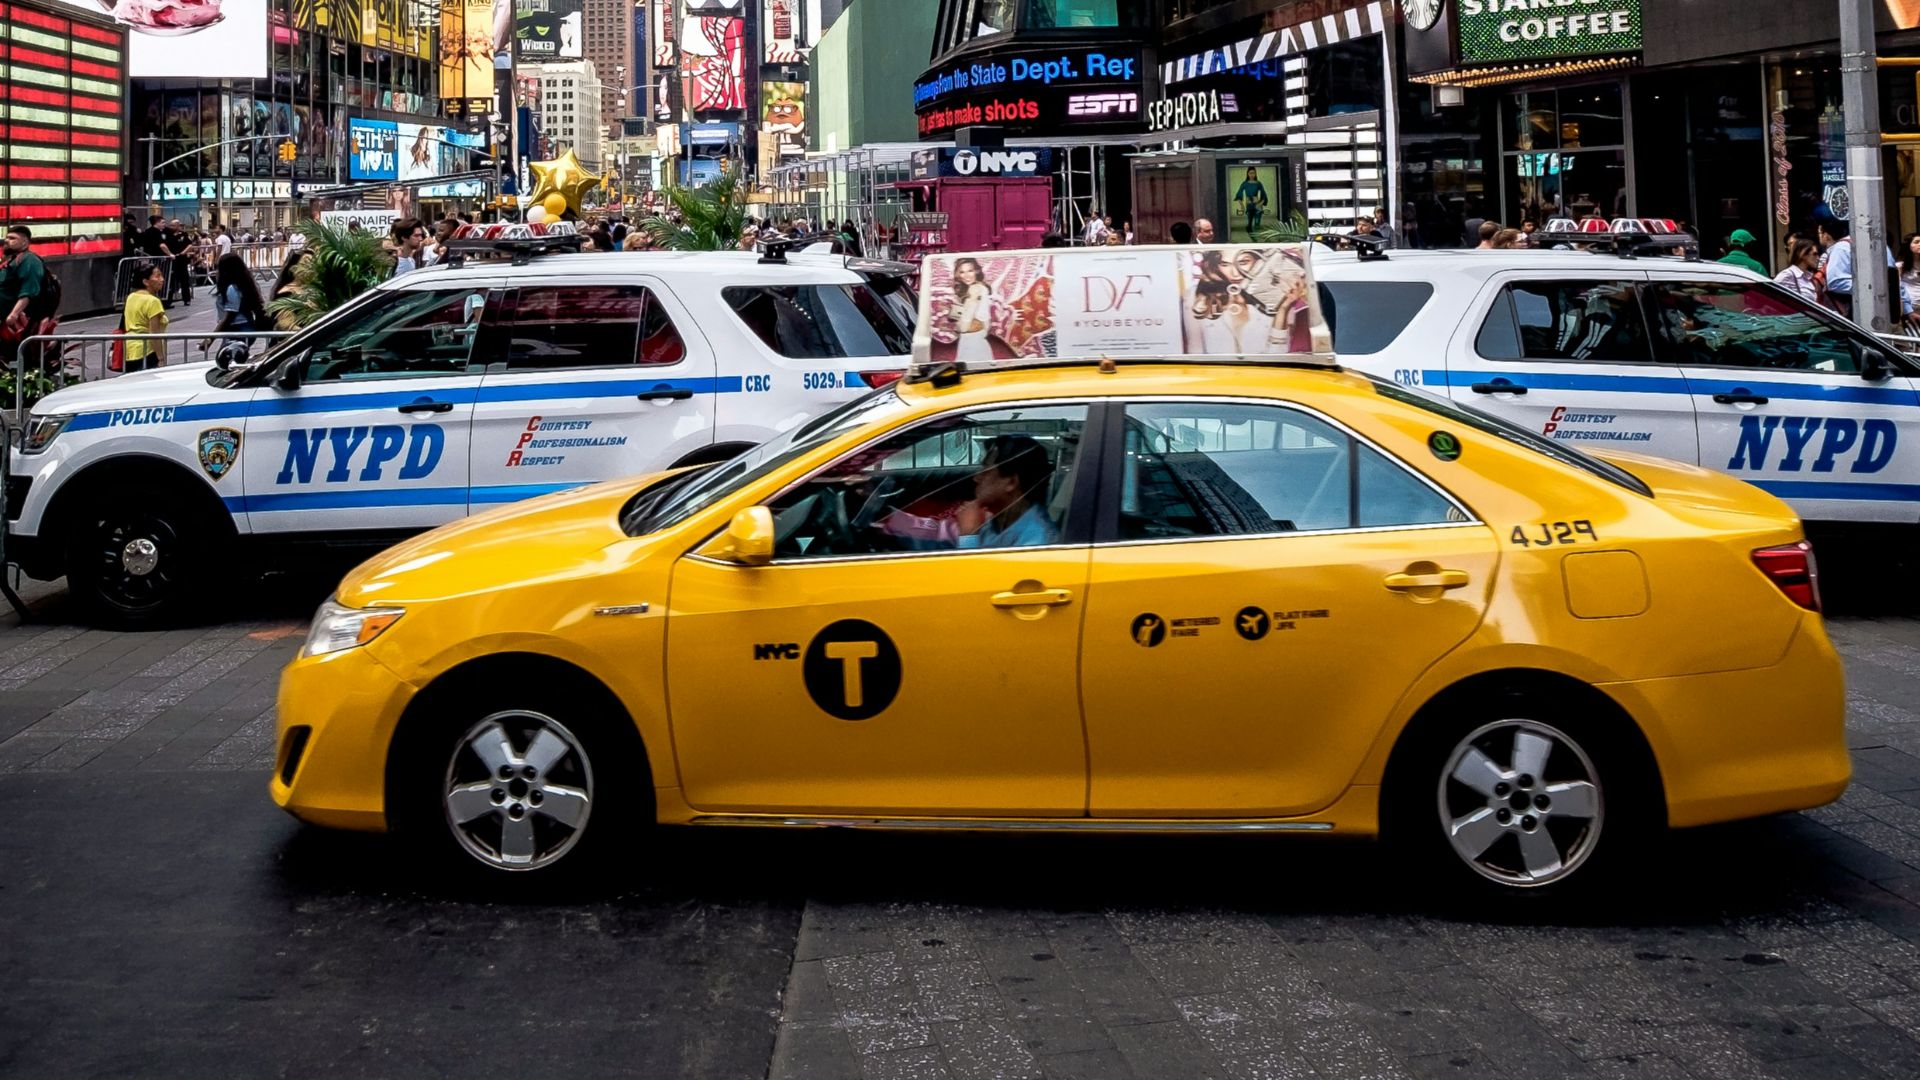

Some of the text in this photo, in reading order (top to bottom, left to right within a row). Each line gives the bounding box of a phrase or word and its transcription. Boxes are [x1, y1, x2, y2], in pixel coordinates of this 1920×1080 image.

[1500, 10, 1630, 42] COFFEE
[954, 69, 968, 89] the
[971, 63, 1006, 86] State
[1012, 56, 1077, 83] Dept.
[955, 102, 981, 125] make
[985, 98, 1039, 122] shots
[1068, 93, 1137, 115] ESPN
[1148, 89, 1220, 131] SEPHORA
[981, 151, 1036, 172] NYC
[325, 215, 395, 226] VISIONAIRE
[745, 374, 771, 392] CRC
[1394, 369, 1419, 386] CRC
[109, 406, 176, 427] POLICE
[527, 415, 592, 432] COURTESY
[1550, 406, 1616, 424] COURTESY
[516, 433, 627, 449] PROFESSIONALISM
[1543, 422, 1652, 442] PROFESSIONALISM
[1727, 415, 1898, 474] NYPD
[275, 423, 445, 485] NYPD
[506, 450, 565, 467] RESPECT
[1170, 617, 1221, 627] METERED
[1273, 609, 1330, 620] FLAT FARE
[1171, 628, 1199, 637] FARE
[1275, 622, 1296, 630] JFK
[754, 643, 800, 660] NYC
